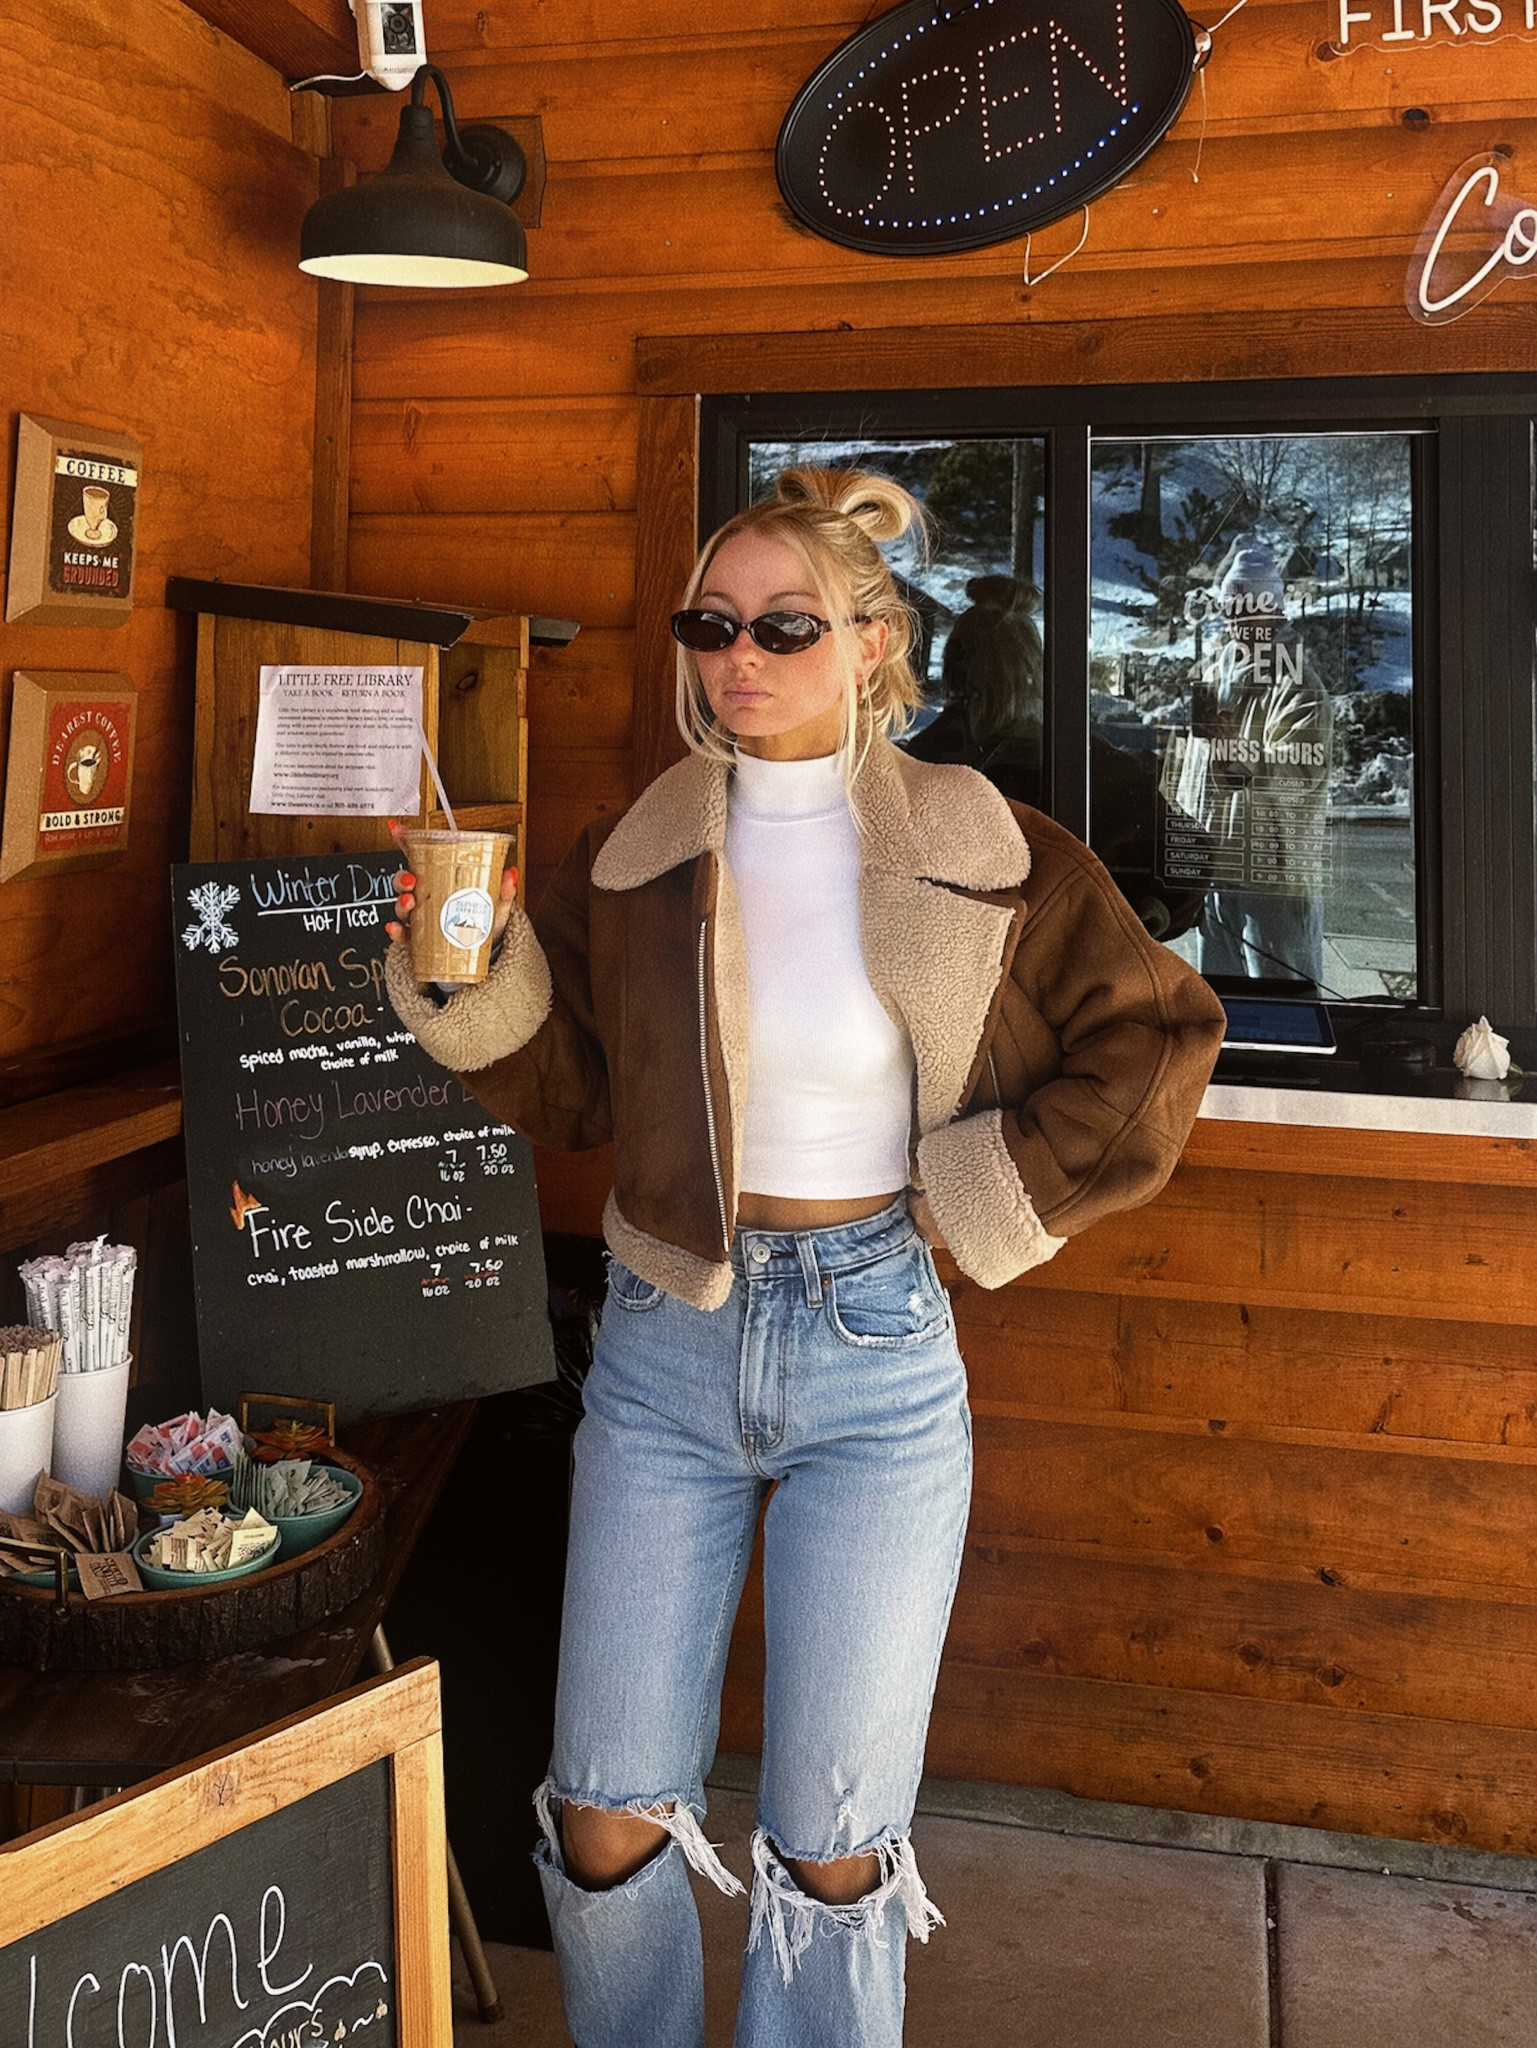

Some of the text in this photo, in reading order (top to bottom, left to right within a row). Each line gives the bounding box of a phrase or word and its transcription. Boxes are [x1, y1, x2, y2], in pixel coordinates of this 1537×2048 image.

[1340, 0, 1534, 44] FIRS
[820, 1, 1126, 217] OPEN
[67, 460, 126, 484] COFFEE
[63, 552, 119, 568] KEEPS ME
[63, 565, 119, 587] GROUNDED
[1184, 584, 1313, 625] Come in
[1228, 626, 1272, 641] WE'RE
[1204, 642, 1304, 686] PEN
[279, 673, 413, 686] LITTLE FREE LIBRARY
[283, 689, 302, 698] TAKE
[304, 689, 309, 697] A
[311, 689, 333, 698] BOOK
[341, 689, 373, 698] RETURN
[381, 690, 405, 699] BOOK
[52, 710, 121, 766] DEAREST COFFEE
[1176, 736, 1325, 766] BINESS HOURS
[45, 810, 120, 828] BOLD & STRONG
[1171, 821, 1208, 829] THURSDA
[1170, 852, 1209, 860] SATURDAY
[250, 864, 402, 907] Winter Drin
[1170, 868, 1201, 876] SUNDAY
[219, 955, 336, 998] Sonoran
[239, 1048, 285, 1073] spiced
[289, 1043, 334, 1061] mocha,
[336, 1035, 381, 1051] vanilla,
[321, 1049, 399, 1071] choice of milk
[235, 1088, 325, 1140] Honey
[332, 1074, 452, 1119] Lavender
[251, 1145, 297, 1178] honey
[443, 1128, 475, 1142] choice
[478, 1125, 490, 1137] of
[492, 1123, 516, 1136] milk
[445, 1143, 508, 1163] 7 7.50
[244, 1206, 312, 1258] Fire
[325, 1200, 395, 1243] Side
[247, 1234, 518, 1286] chai, toasted marshmallow, choice of milk
[430, 1260, 503, 1276] 7 7.50
